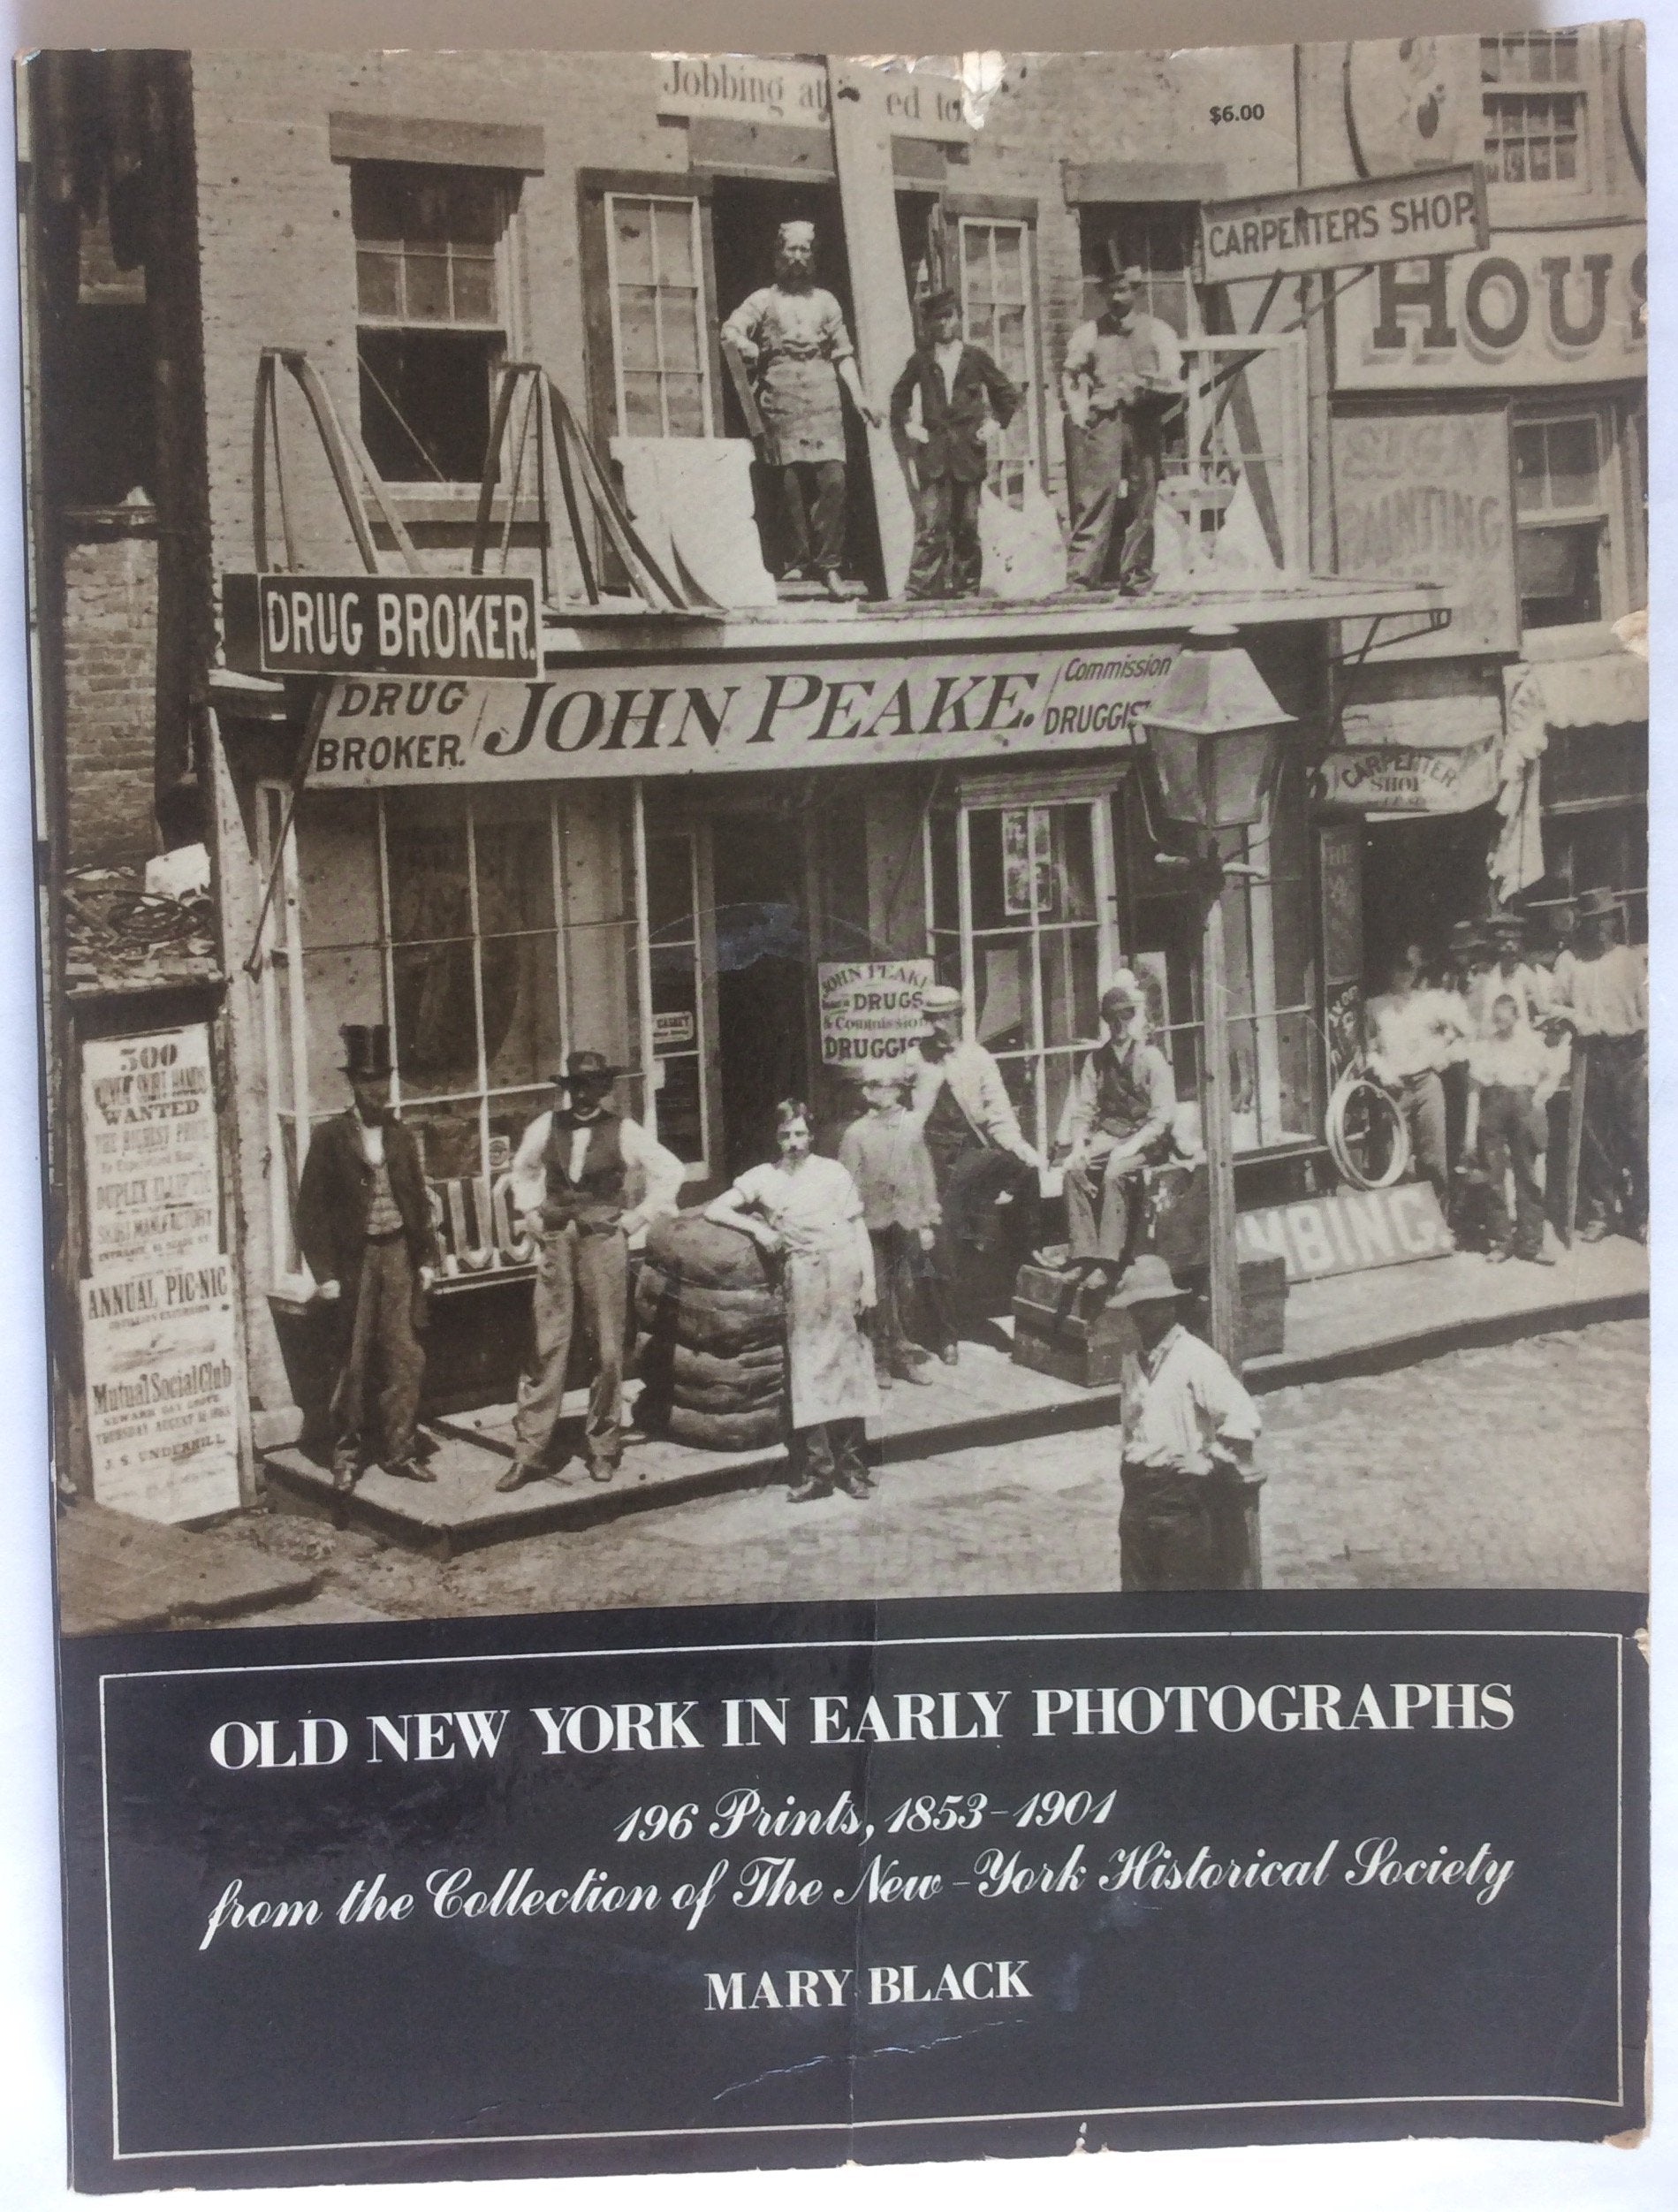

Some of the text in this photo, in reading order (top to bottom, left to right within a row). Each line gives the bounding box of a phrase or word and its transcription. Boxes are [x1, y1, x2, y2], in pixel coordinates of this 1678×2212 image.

[664, 61, 783, 118] Jobbing
[1209, 103, 1265, 126] $6.00
[1209, 204, 1379, 258] CARPENTERS
[1373, 251, 1647, 349] HOU
[267, 590, 536, 660] DRUG BROKER.
[337, 656, 1173, 756] DRUG JOHN PEAKE. Commission
[316, 734, 466, 772] BROKER.
[854, 992, 924, 1010] DRUGS
[100, 1098, 200, 1126] WANTED
[89, 1278, 158, 1320] ANNUAL
[93, 1358, 232, 1415] Mutual Social Club
[210, 1683, 1515, 1769] OLD NEW YORK IN EARLY PHOTOGRAPHS
[615, 1803, 699, 1843] 196
[709, 1789, 875, 1847] Prints,
[199, 1879, 323, 1950] from
[337, 1874, 414, 1925] the
[426, 1866, 658, 1919] Collection
[671, 1859, 729, 1931] of
[733, 1857, 823, 1907] The
[1099, 1840, 1340, 1891] Historical
[1345, 1836, 1515, 1905] Society
[704, 1960, 1033, 2011] MARY BLACK
